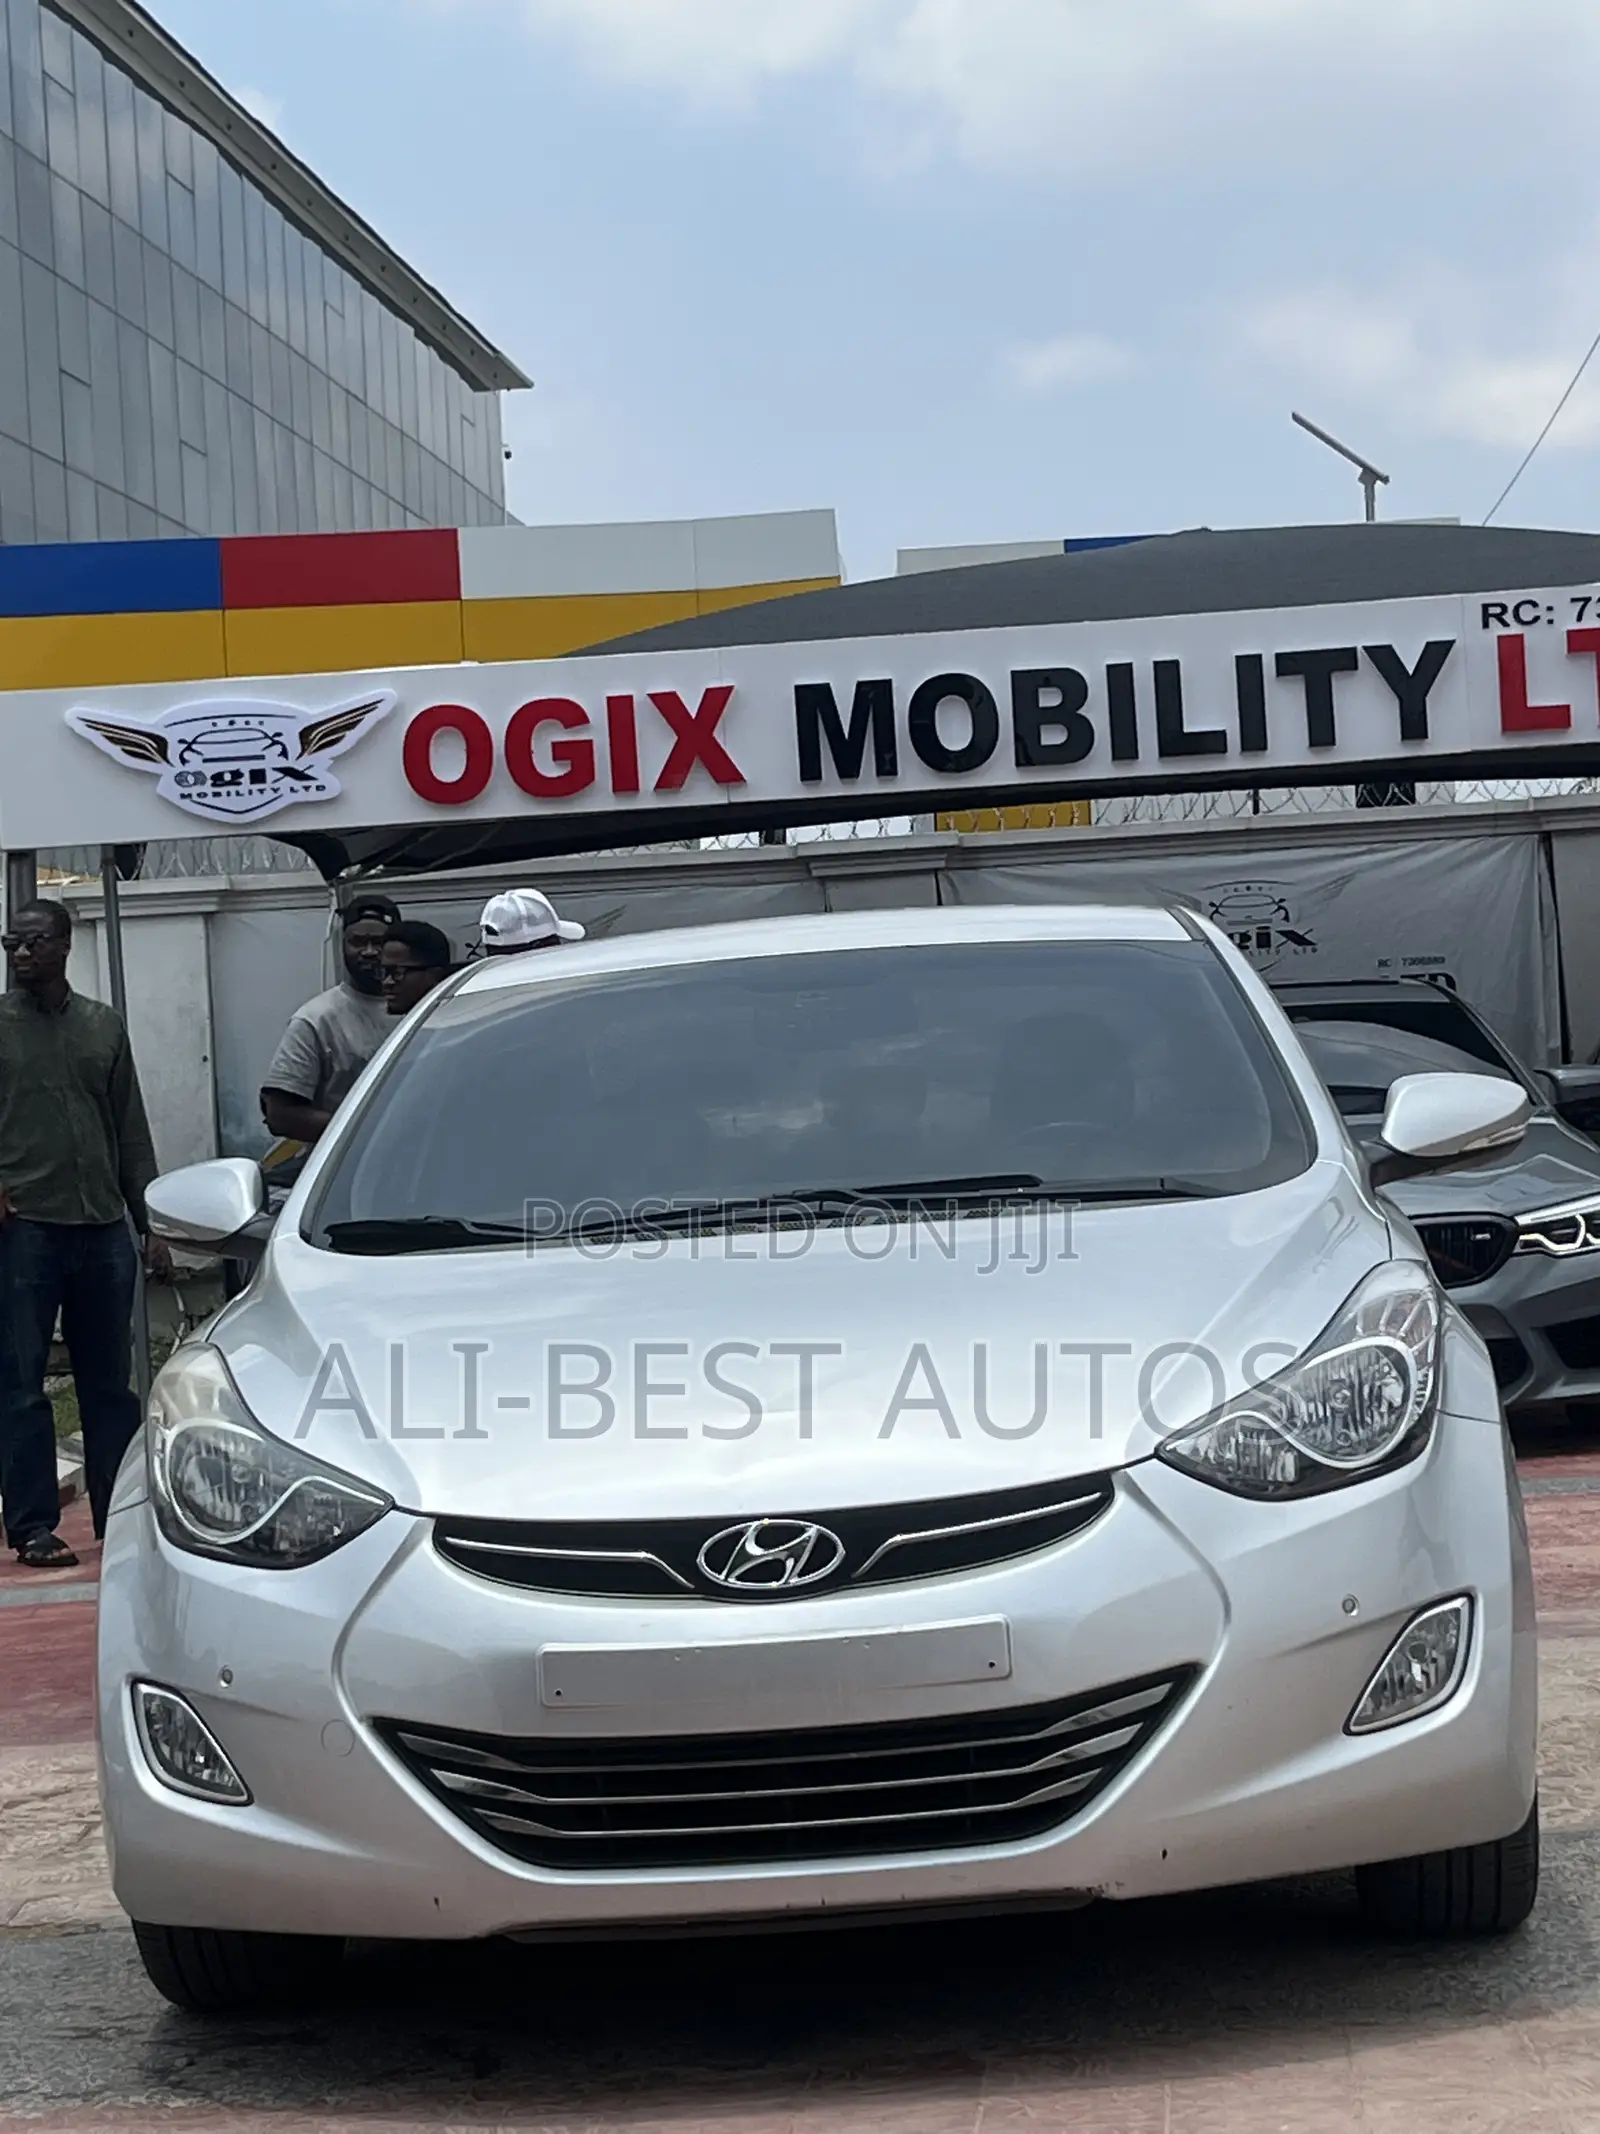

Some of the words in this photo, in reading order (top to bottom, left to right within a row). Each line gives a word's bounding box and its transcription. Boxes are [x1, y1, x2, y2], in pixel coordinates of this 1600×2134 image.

[1481, 599, 1554, 630] RC:
[1570, 596, 1600, 623] 7
[402, 684, 748, 806] OGIX
[794, 639, 1456, 783] MOBILITY
[179, 787, 281, 800] MOBILITY
[289, 784, 327, 794] LTD
